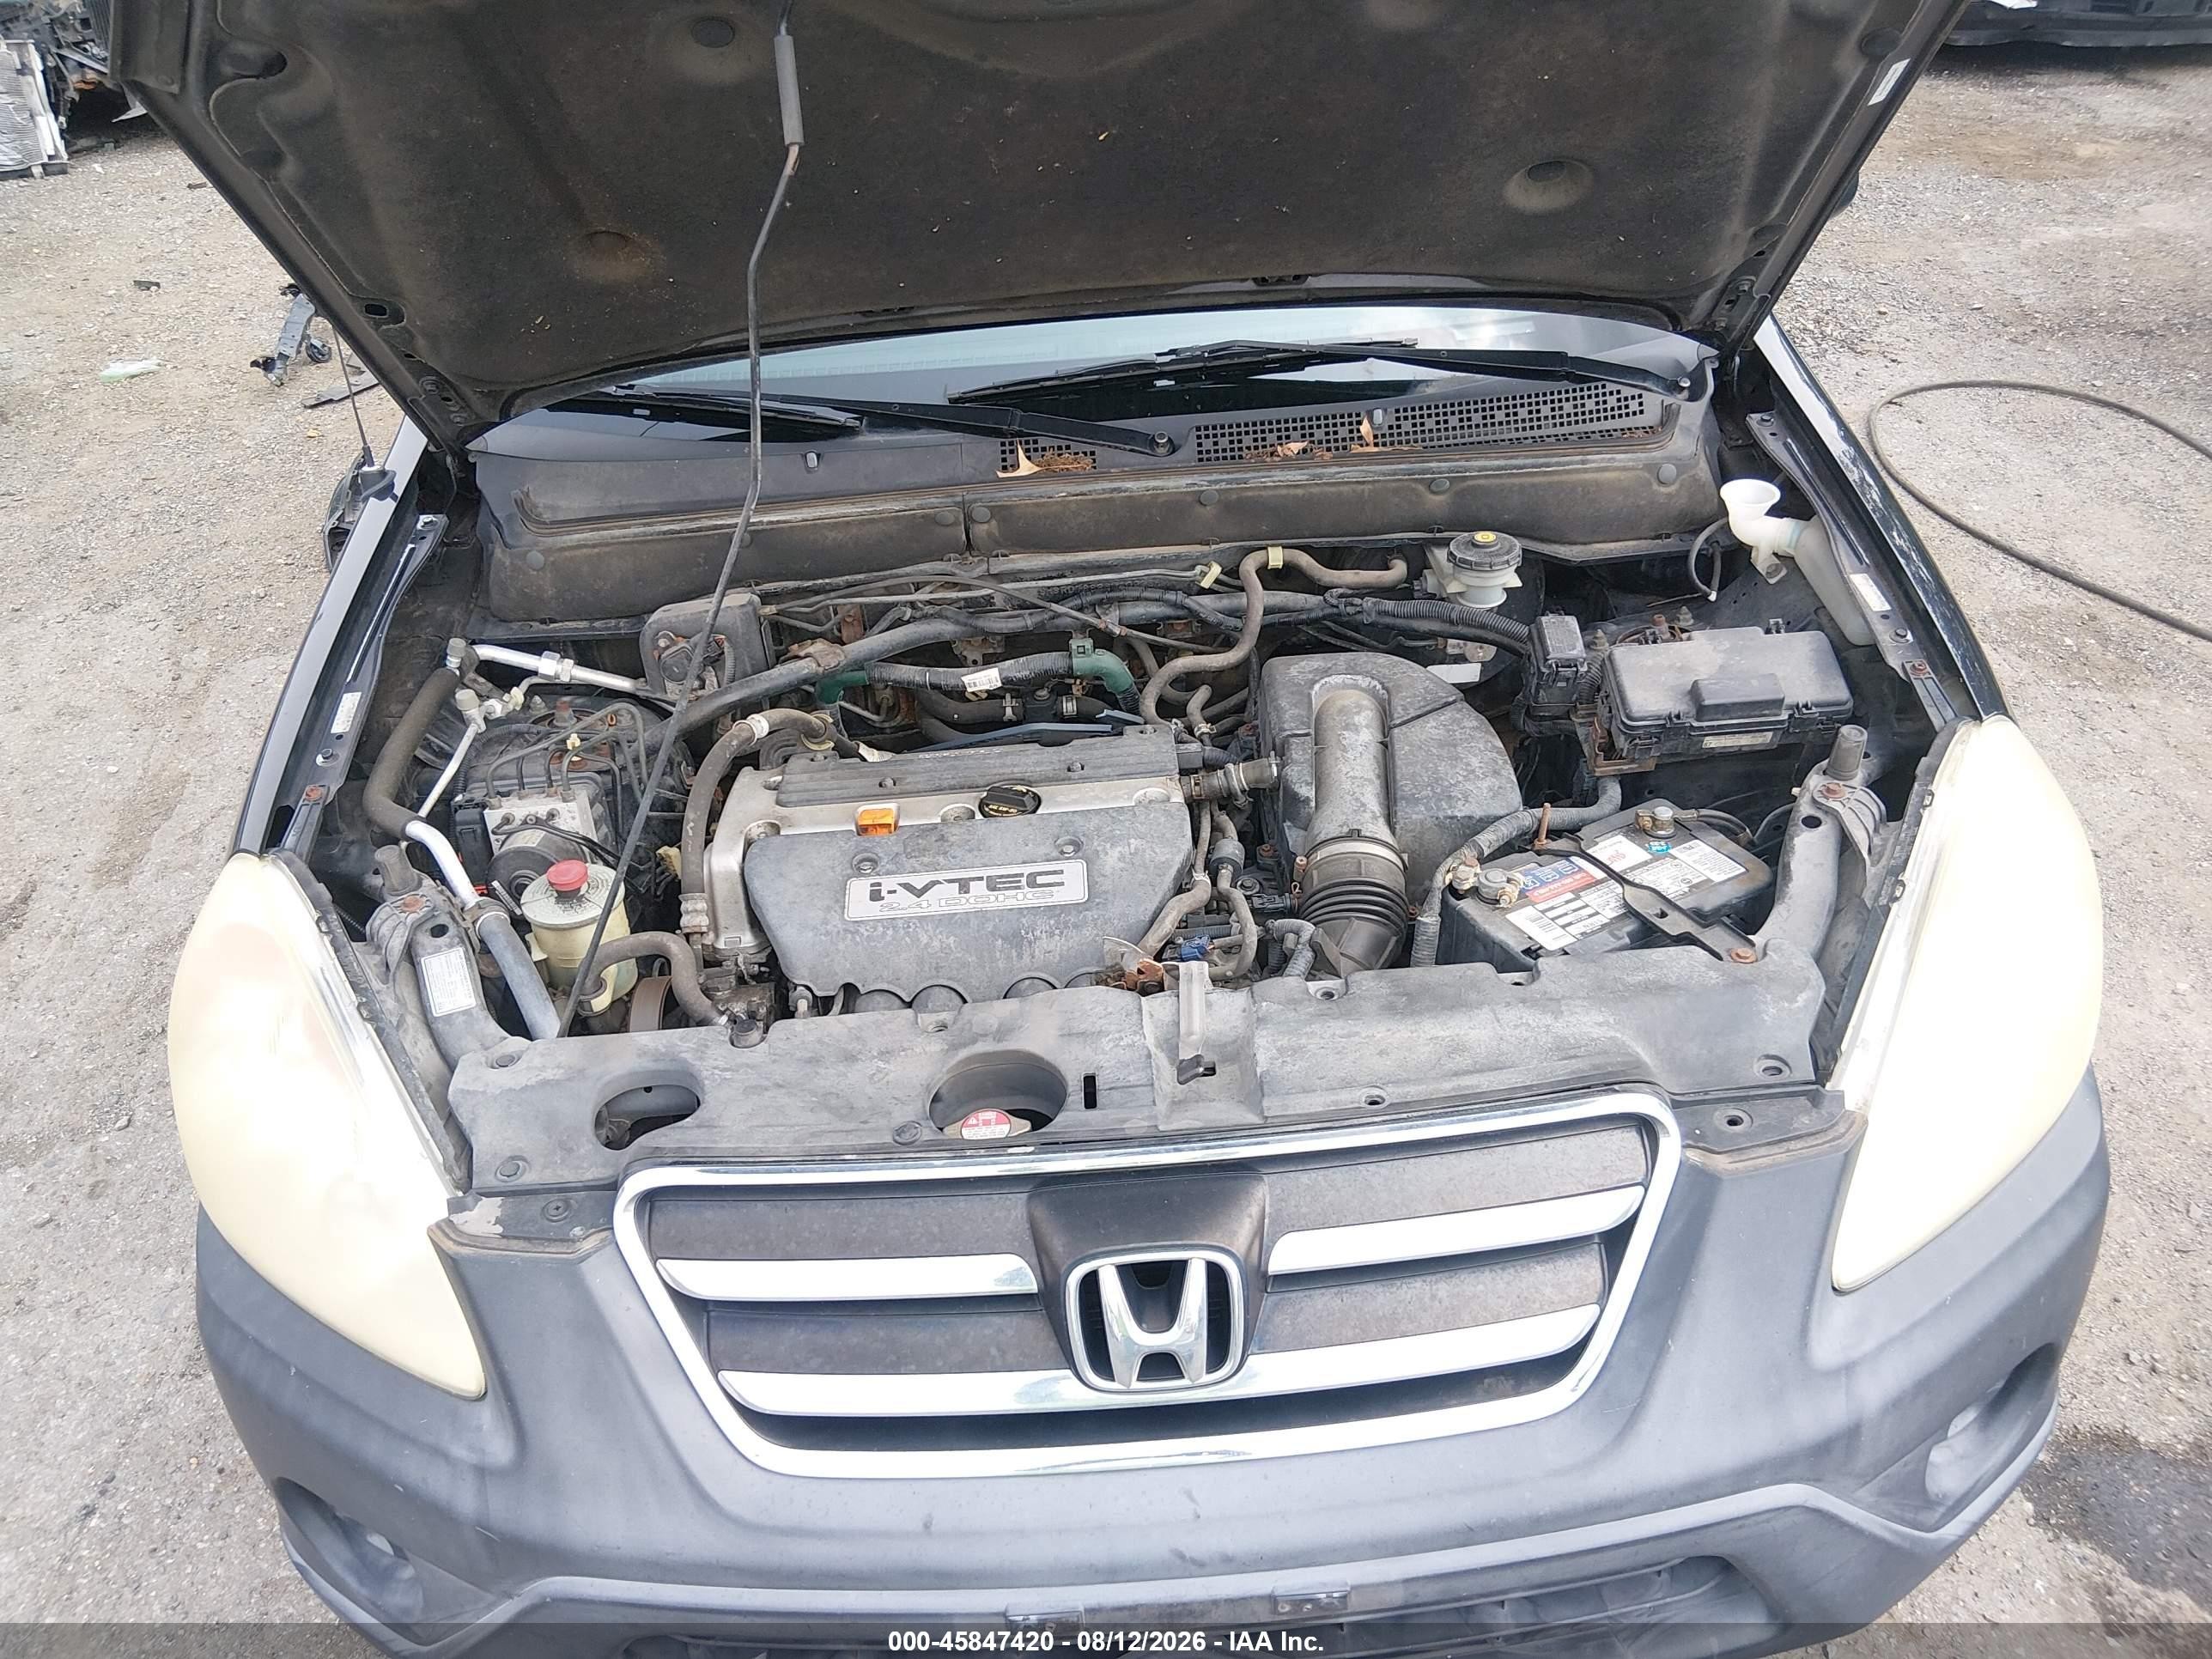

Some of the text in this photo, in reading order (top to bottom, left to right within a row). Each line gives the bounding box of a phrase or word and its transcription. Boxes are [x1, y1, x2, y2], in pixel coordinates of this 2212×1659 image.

[869, 869, 1066, 902] i-VTEC
[878, 889, 1054, 913] 2.4 DOHC
